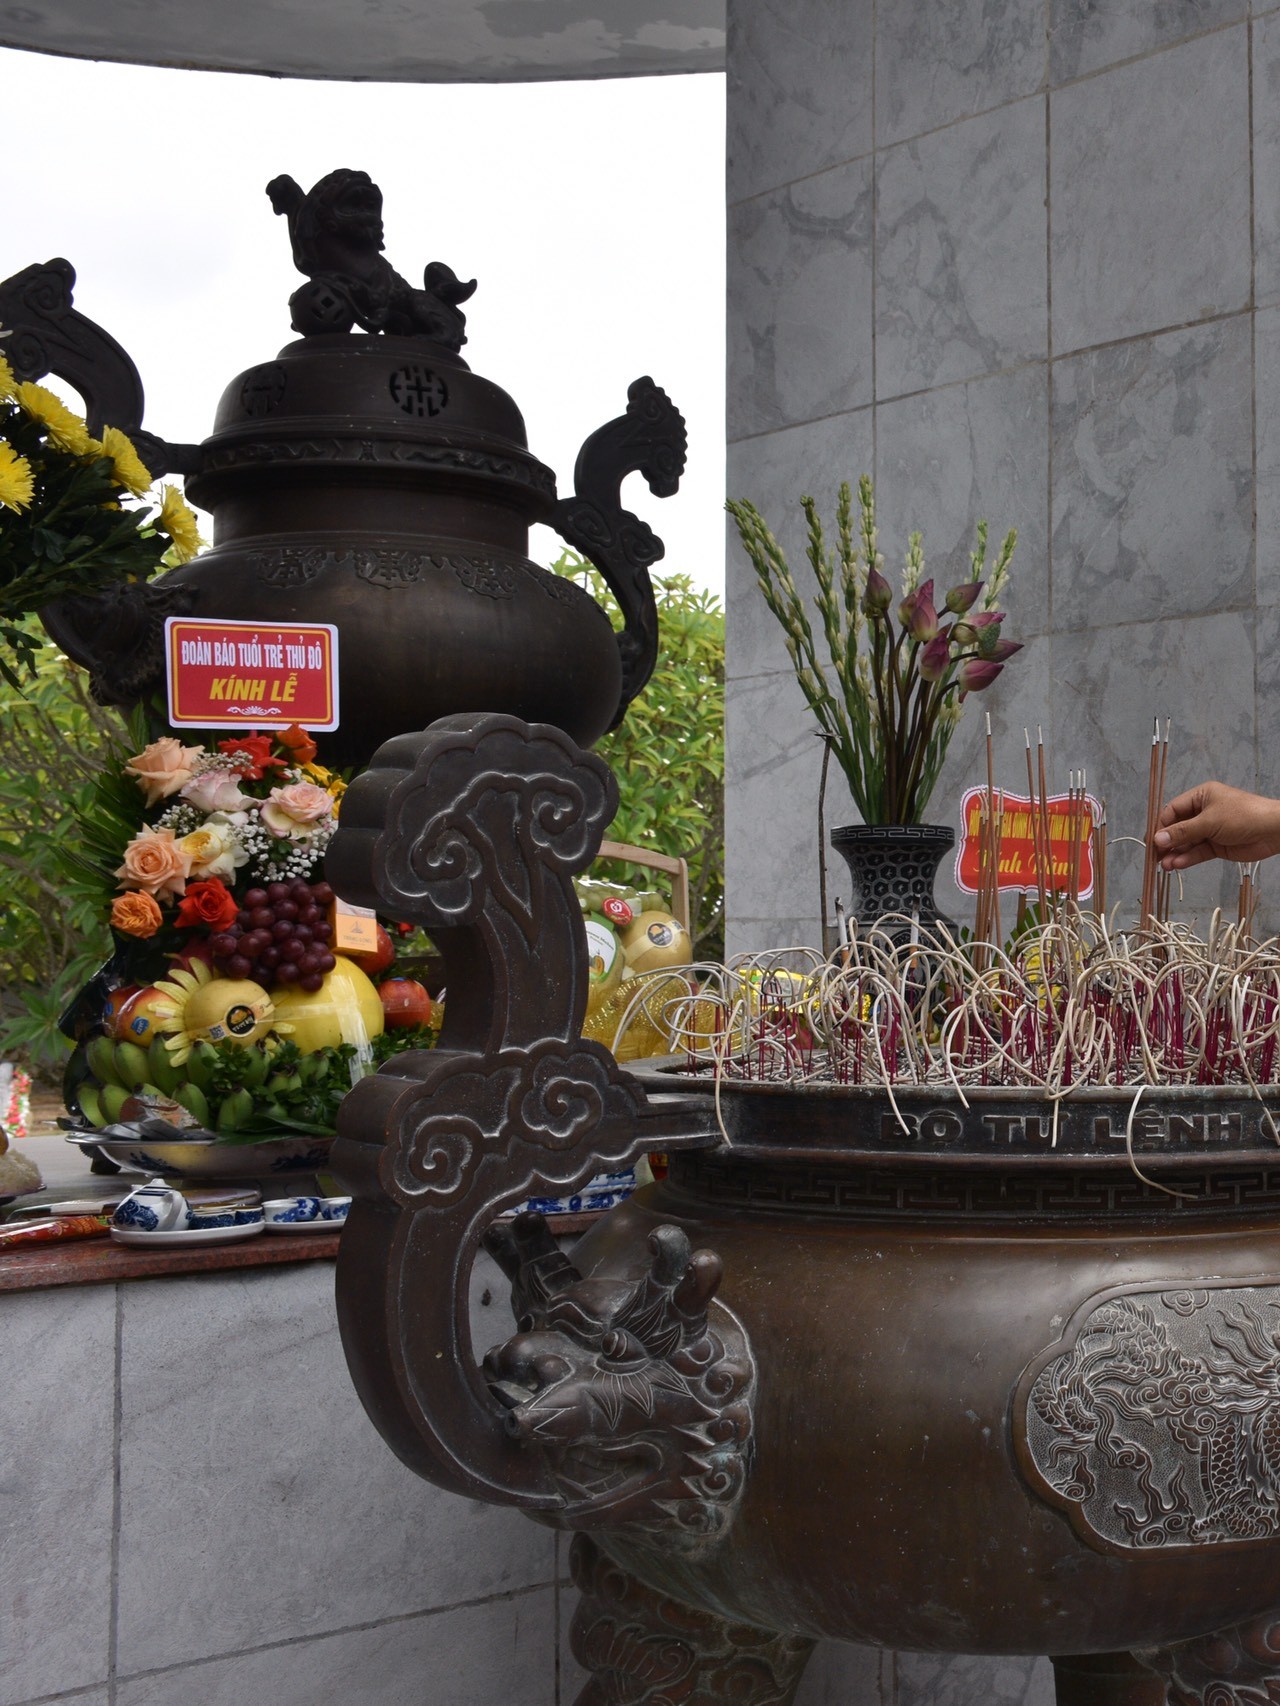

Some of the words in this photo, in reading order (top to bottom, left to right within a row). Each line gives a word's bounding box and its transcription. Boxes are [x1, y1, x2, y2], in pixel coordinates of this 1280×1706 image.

[181, 637, 212, 666] ĐOÀN
[214, 638, 236, 667] BÁO
[238, 634, 263, 668] TUỔI
[264, 634, 284, 669] TRẺ
[286, 635, 305, 669] THỦ
[308, 641, 322, 670] ĐÔ
[209, 674, 266, 702] KÍNH
[270, 672, 298, 702] LỄ
[881, 1108, 963, 1146] BỘ
[982, 1111, 1070, 1144] TƯ
[1094, 1108, 1243, 1149] LỆNH
